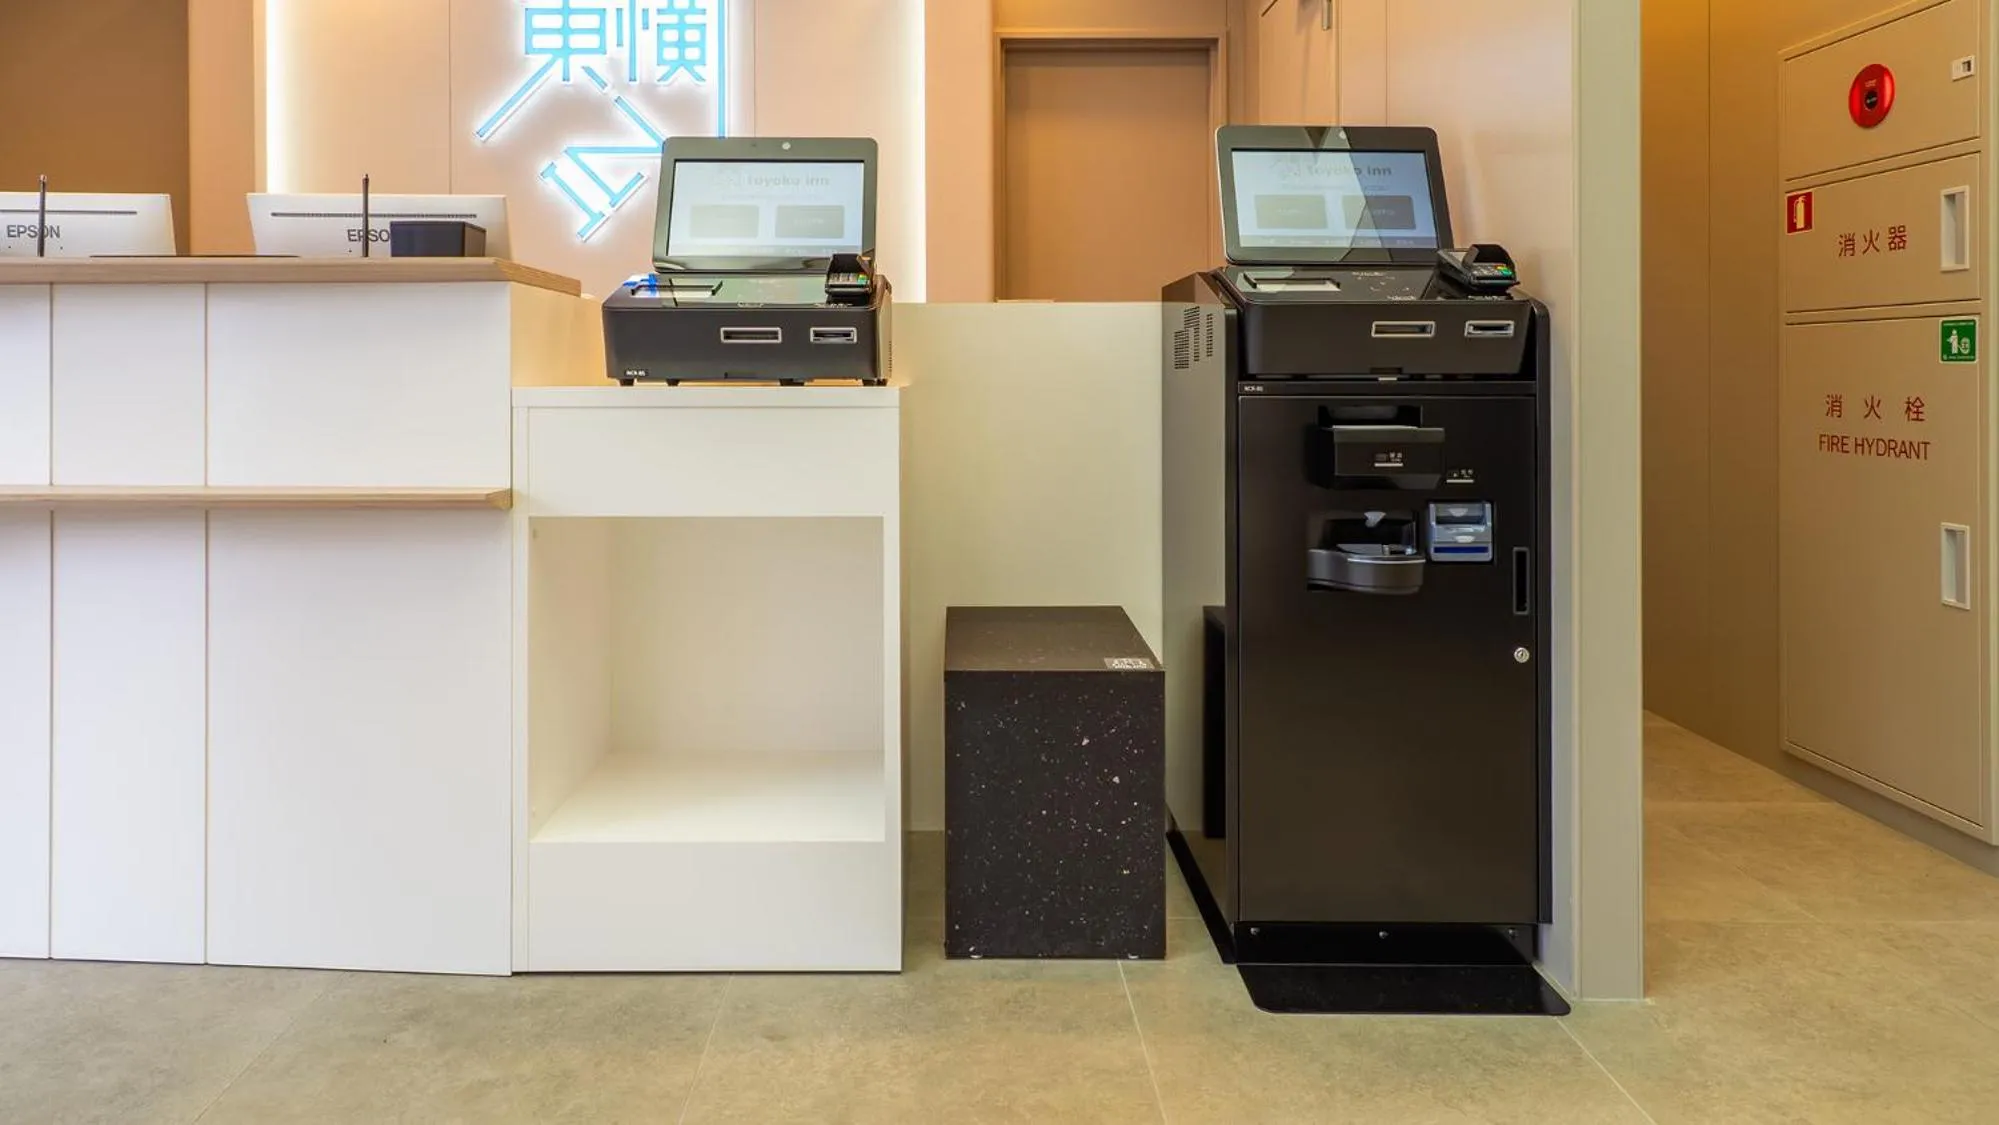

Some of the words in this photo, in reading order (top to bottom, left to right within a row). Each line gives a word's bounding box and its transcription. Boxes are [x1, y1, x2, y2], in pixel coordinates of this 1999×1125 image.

[1838, 224, 1907, 258] 消火器
[1825, 394, 1925, 422] 消火栓
[1818, 433, 1850, 454] FIRE
[1854, 436, 1931, 461] HYDRANT
